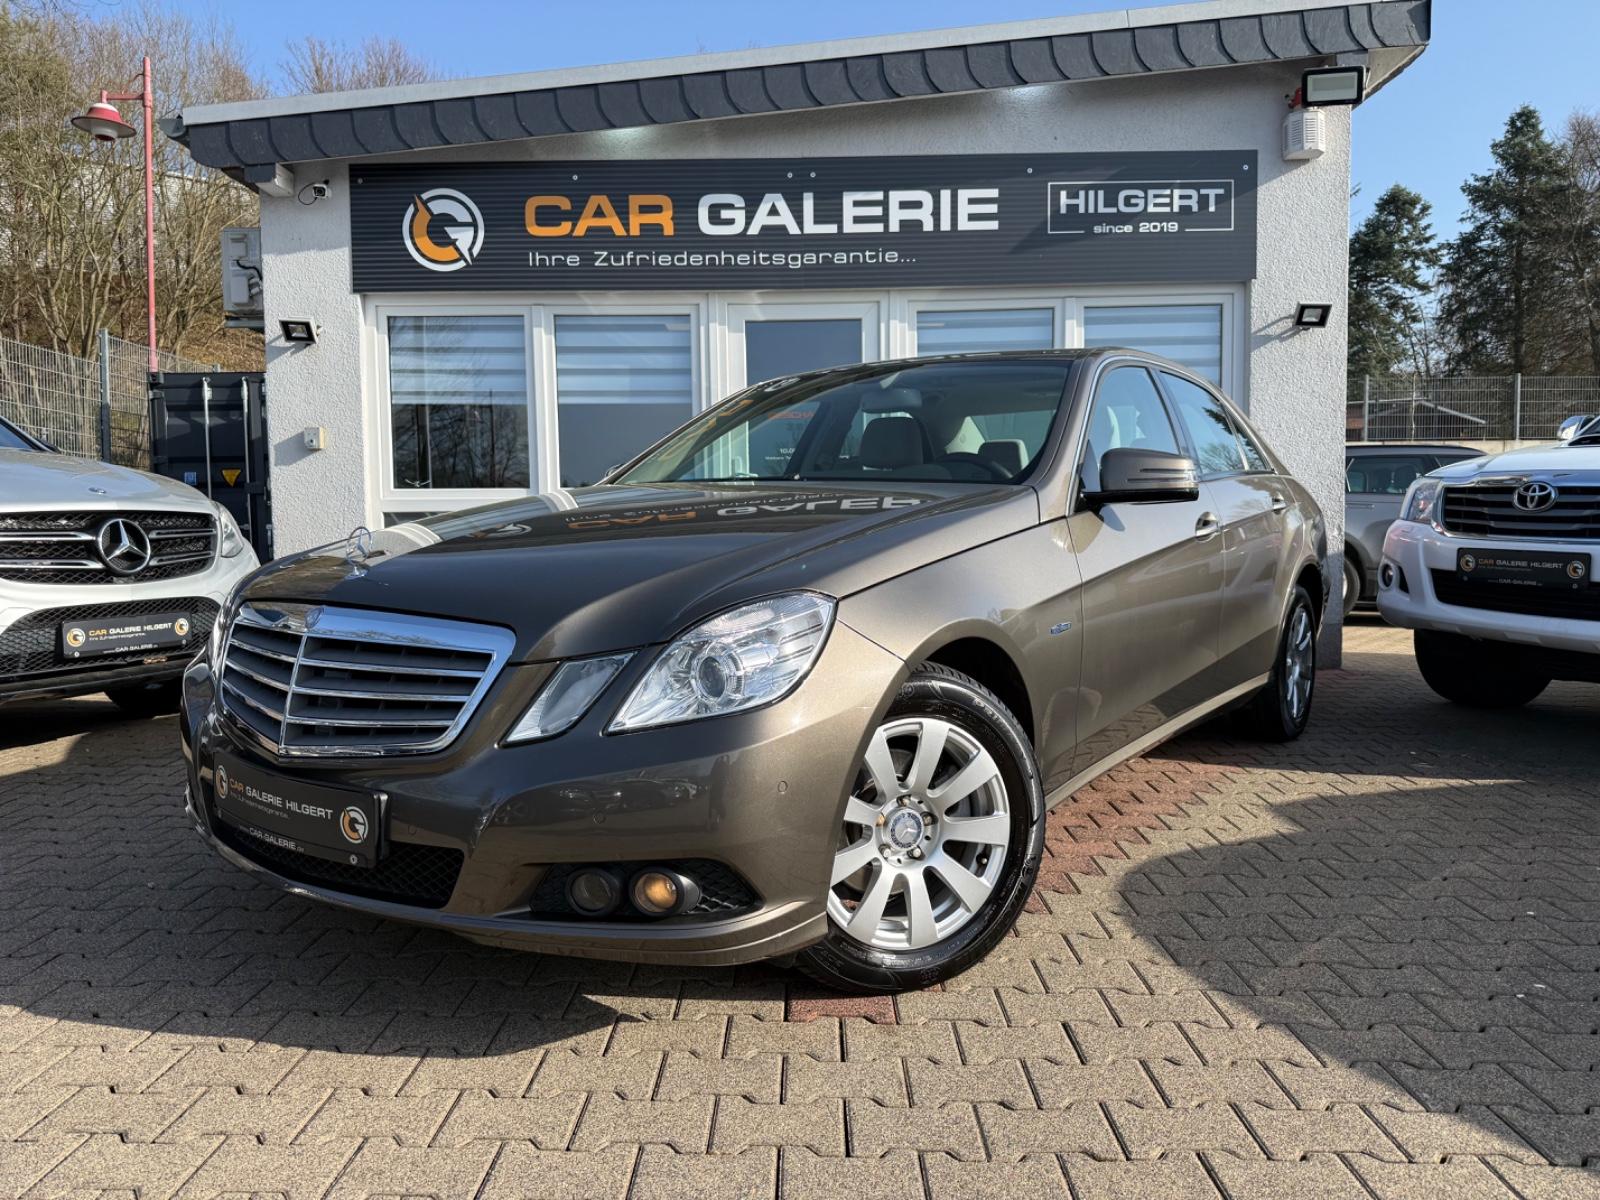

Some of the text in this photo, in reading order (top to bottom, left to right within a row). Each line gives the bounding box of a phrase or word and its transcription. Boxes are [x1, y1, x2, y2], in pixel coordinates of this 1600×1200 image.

[1059, 188, 1226, 215] HILGERT
[525, 188, 1000, 238] CAR GALERIE
[1093, 221, 1180, 235] since 2019
[528, 250, 581, 268] Ihre
[1496, 559, 1528, 567] GALERIE
[1530, 561, 1563, 569] HILGERT
[109, 625, 141, 634] GALERIE
[143, 622, 173, 631] HILGERT
[229, 778, 245, 793] CAR
[245, 786, 283, 808] GALERIE
[286, 799, 333, 819] HILGERT
